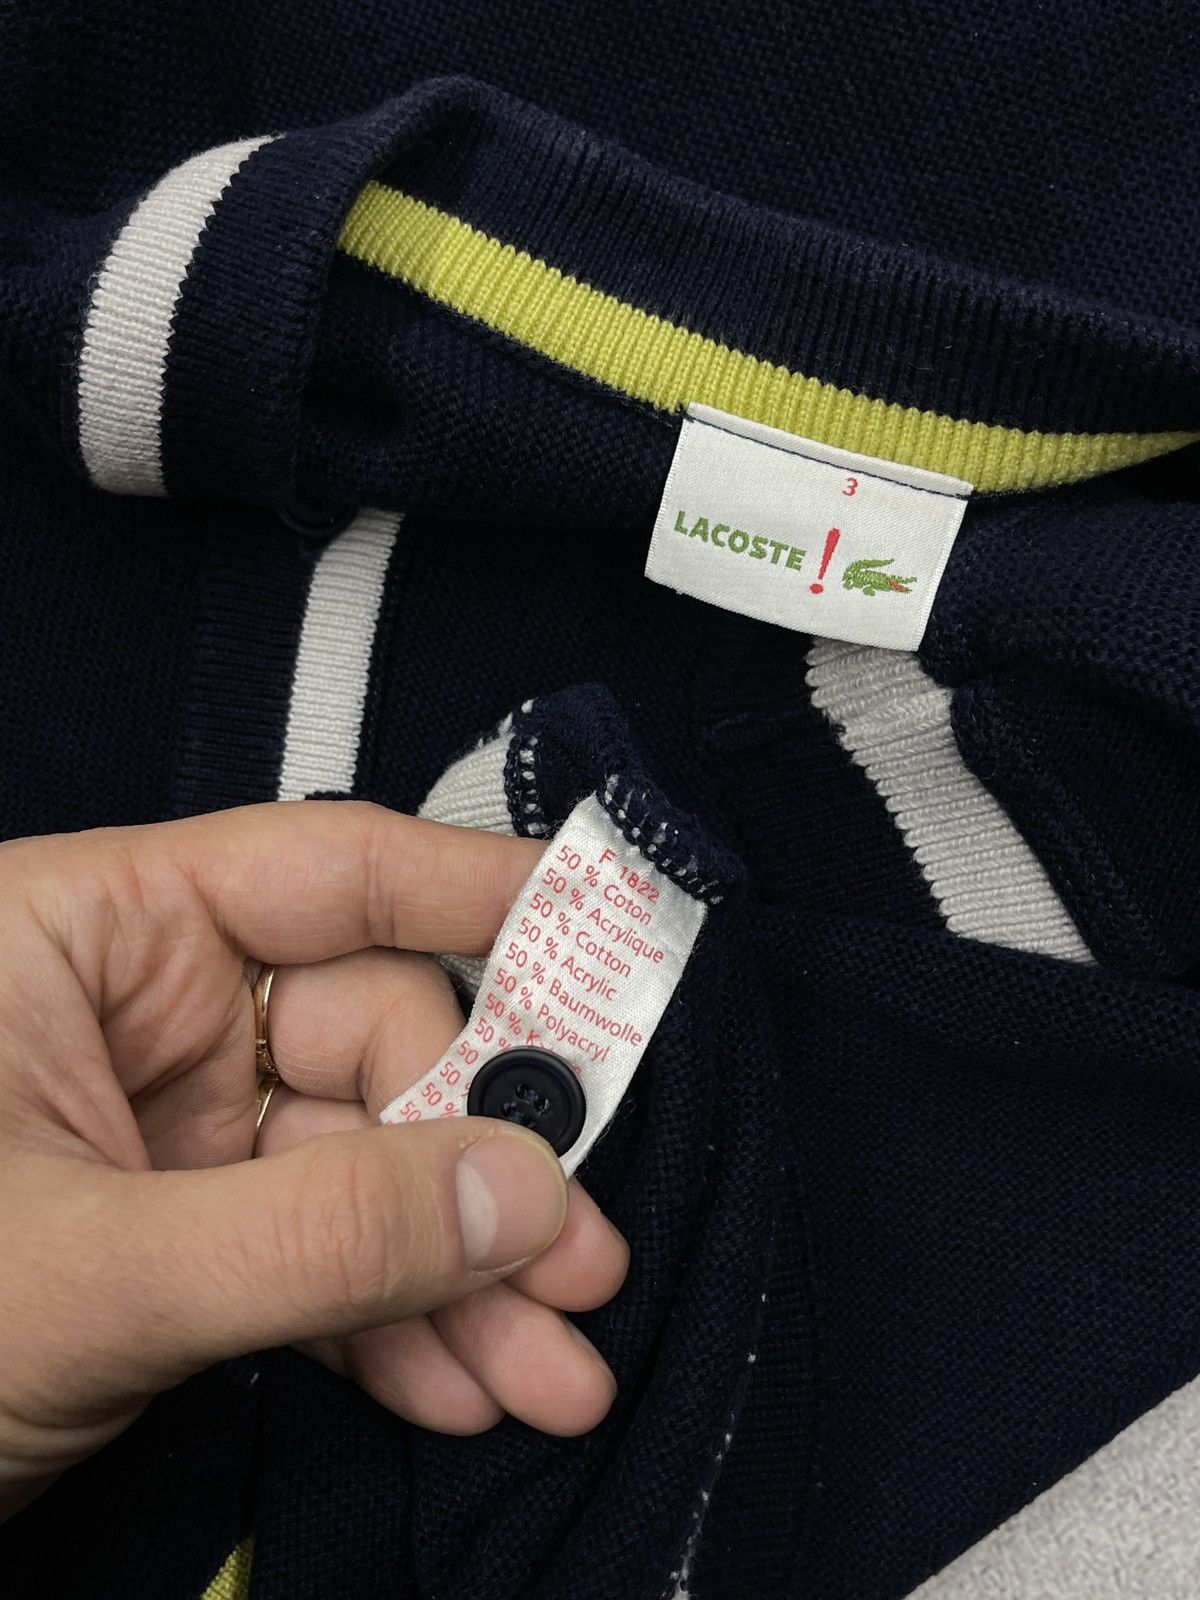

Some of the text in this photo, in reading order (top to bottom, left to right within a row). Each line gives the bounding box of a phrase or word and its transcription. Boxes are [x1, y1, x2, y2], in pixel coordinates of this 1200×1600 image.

[842, 477, 858, 496] 3
[674, 511, 806, 571] LACOSTE
[557, 845, 651, 925] 50 % Coton
[599, 849, 661, 904] F 1822
[529, 892, 632, 977] 50 % Cotton
[542, 868, 664, 964] 50 % Acrylique
[519, 917, 617, 1000] 50 % Acrylic
[485, 993, 522, 1036] 50 %
[494, 968, 517, 994] 50
[519, 987, 531, 1010] %
[537, 1004, 610, 1062] Polyacryl
[505, 942, 643, 1047] 50 % Baumwolle
[457, 1041, 479, 1065] 50
[475, 1017, 494, 1043] 50
[422, 1082, 442, 1106] 50
[440, 1062, 461, 1085] 50
